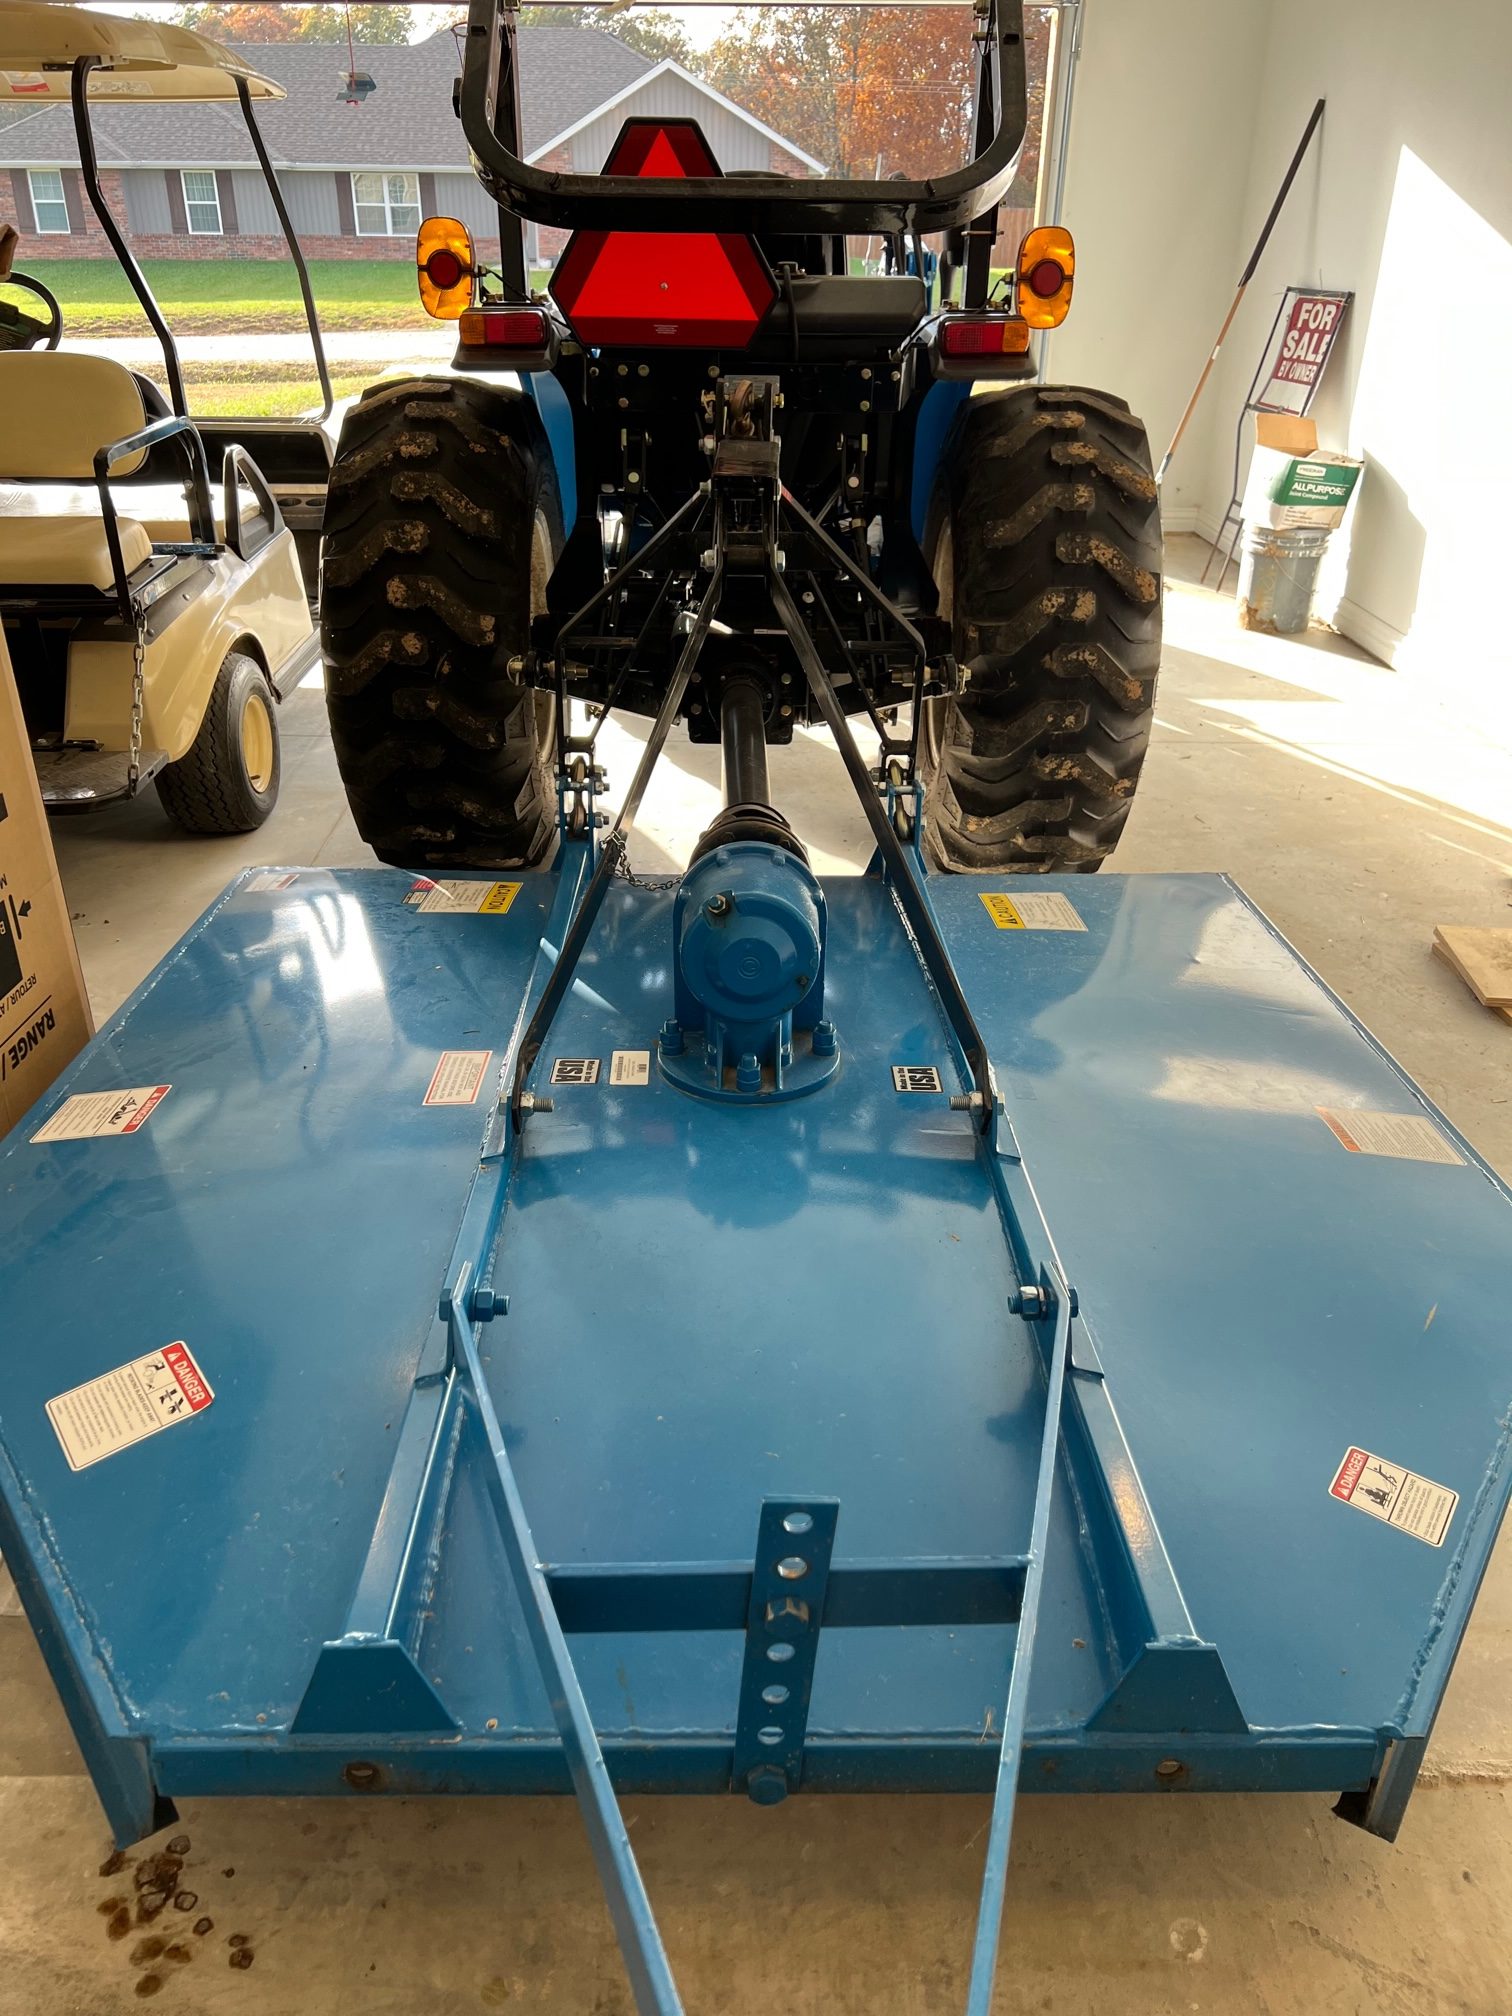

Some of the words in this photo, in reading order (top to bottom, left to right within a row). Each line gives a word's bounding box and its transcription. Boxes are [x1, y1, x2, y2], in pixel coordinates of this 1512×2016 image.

[1297, 302, 1337, 331] FOR
[1282, 329, 1332, 363] SALE
[1277, 360, 1292, 378] BY
[1288, 361, 1318, 383] OWNER
[1301, 492, 1329, 500] Compound
[486, 888, 511, 910] CAUTION
[987, 895, 1013, 918] CAUTION
[10, 973, 37, 1005] RETOUR
[8, 1008, 56, 1070] RANGE
[555, 1060, 585, 1082] USA
[907, 1067, 937, 1090] USA
[129, 1098, 158, 1126] DANGER
[173, 1360, 205, 1404] DANGER
[1340, 1452, 1366, 1489] DANGER
